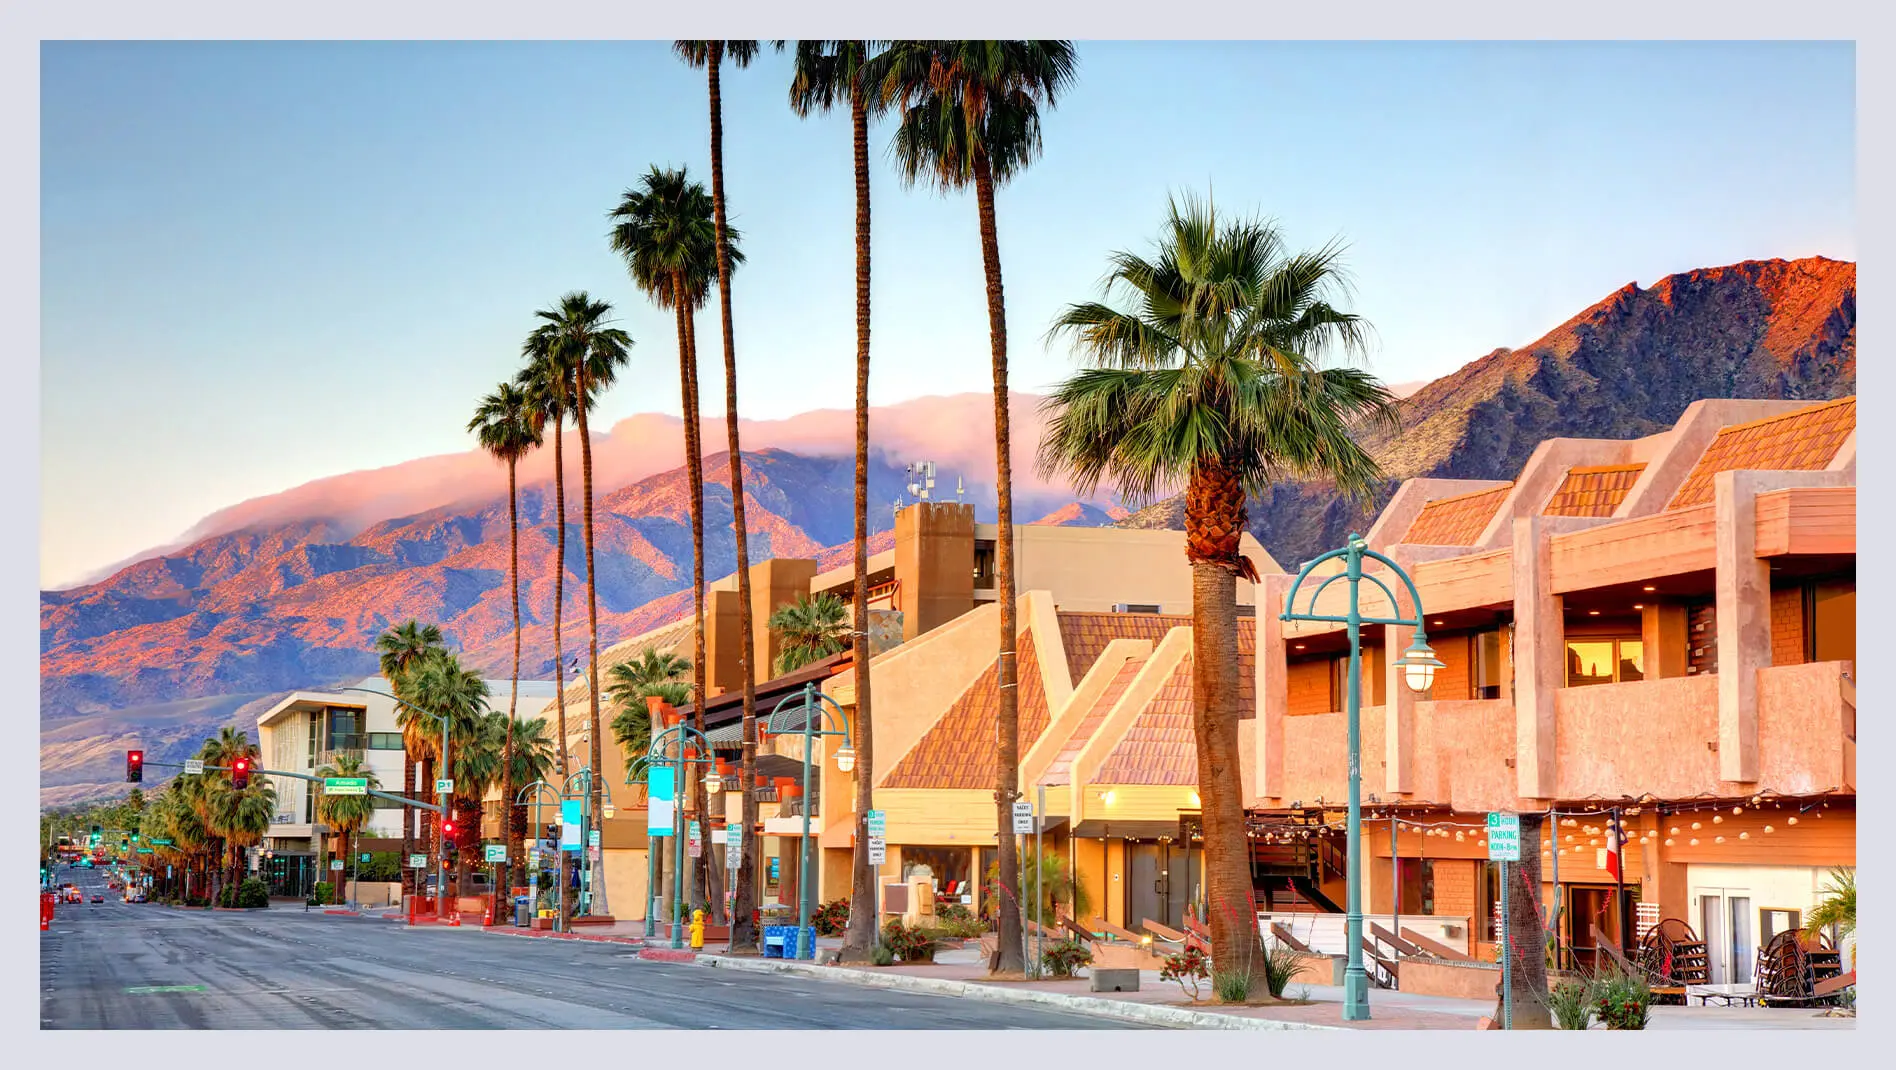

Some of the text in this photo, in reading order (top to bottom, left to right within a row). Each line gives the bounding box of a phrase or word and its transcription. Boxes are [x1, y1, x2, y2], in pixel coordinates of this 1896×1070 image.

[438, 782, 445, 791] P
[1491, 814, 1517, 825] 3 HOUR
[1491, 830, 1517, 840] PARKING
[487, 849, 497, 860] P
